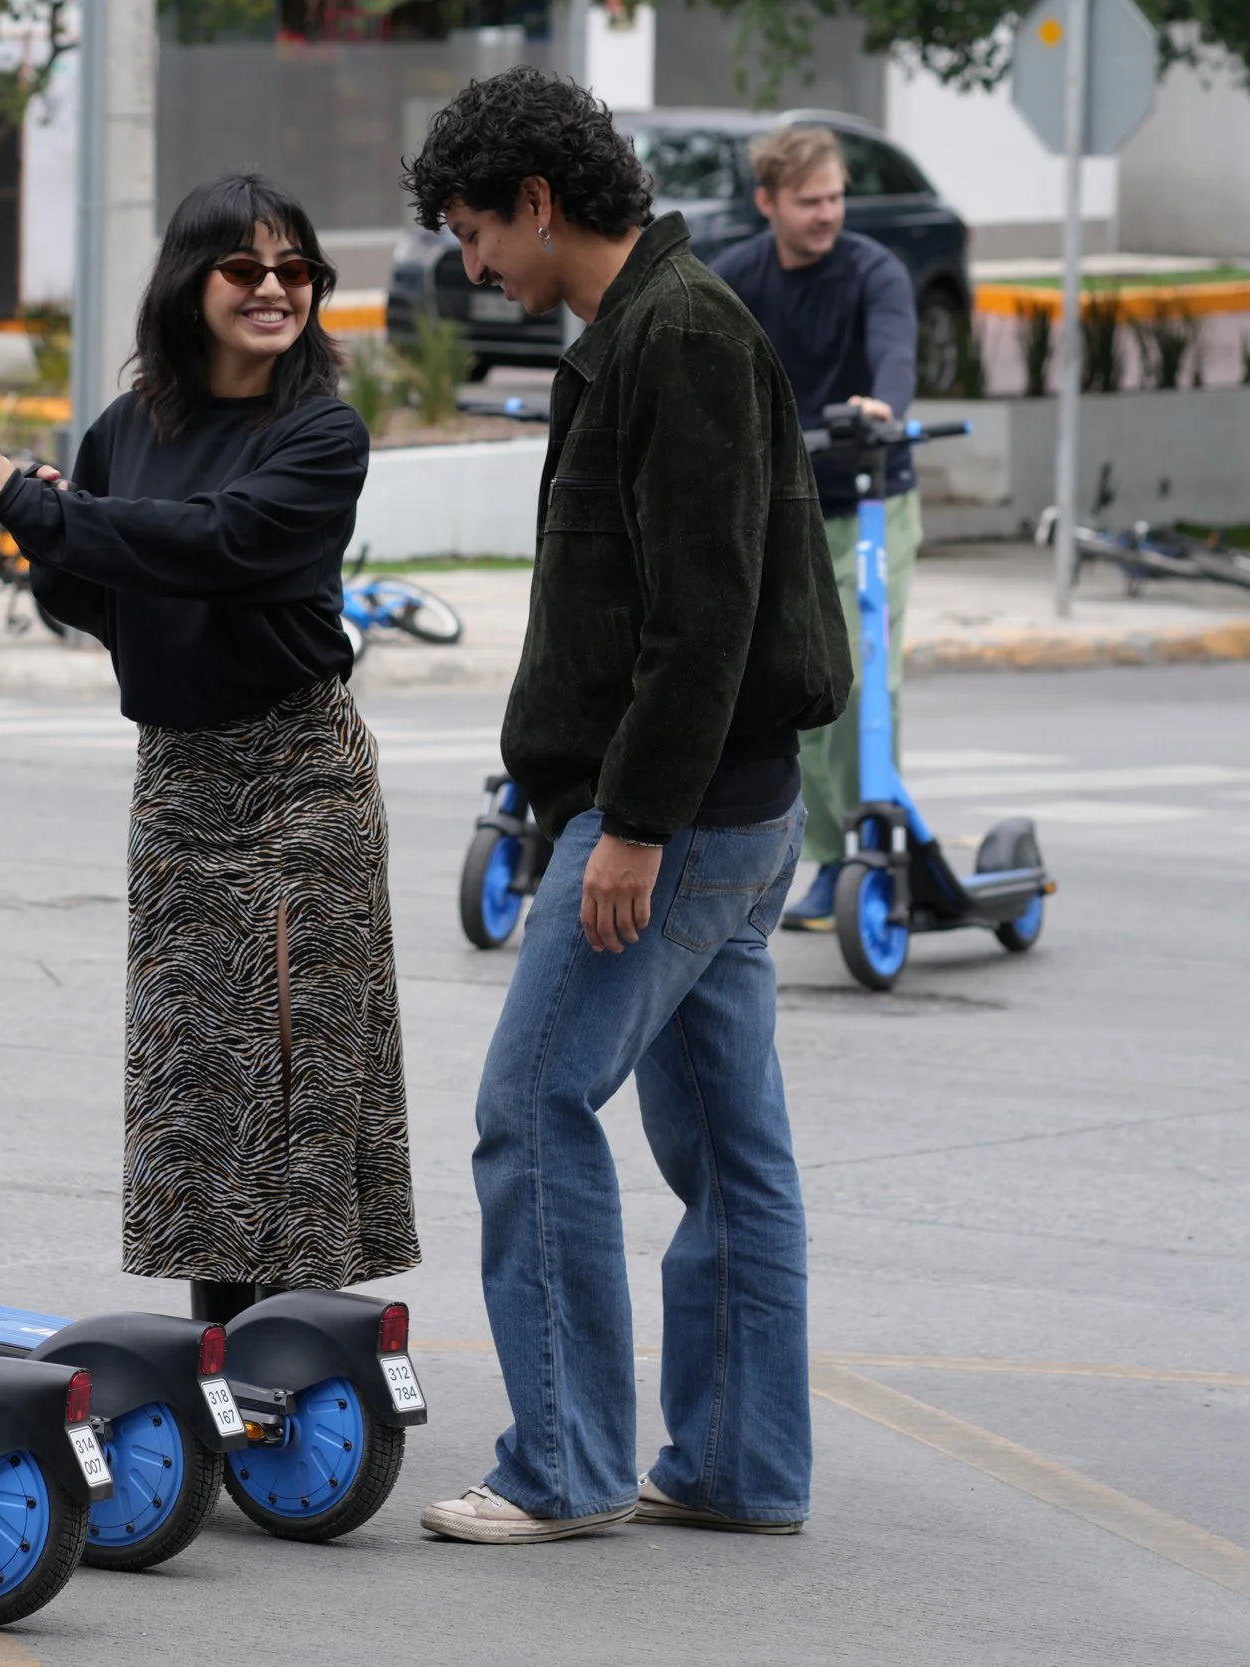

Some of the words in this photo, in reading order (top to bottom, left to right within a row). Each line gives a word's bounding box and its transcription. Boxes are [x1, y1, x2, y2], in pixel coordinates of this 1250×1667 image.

[388, 1366, 410, 1381] 312
[209, 1389, 228, 1405] 318
[395, 1386, 417, 1401] 784
[218, 1409, 235, 1425] 167
[76, 1437, 95, 1454] 314
[84, 1458, 102, 1475] 007
